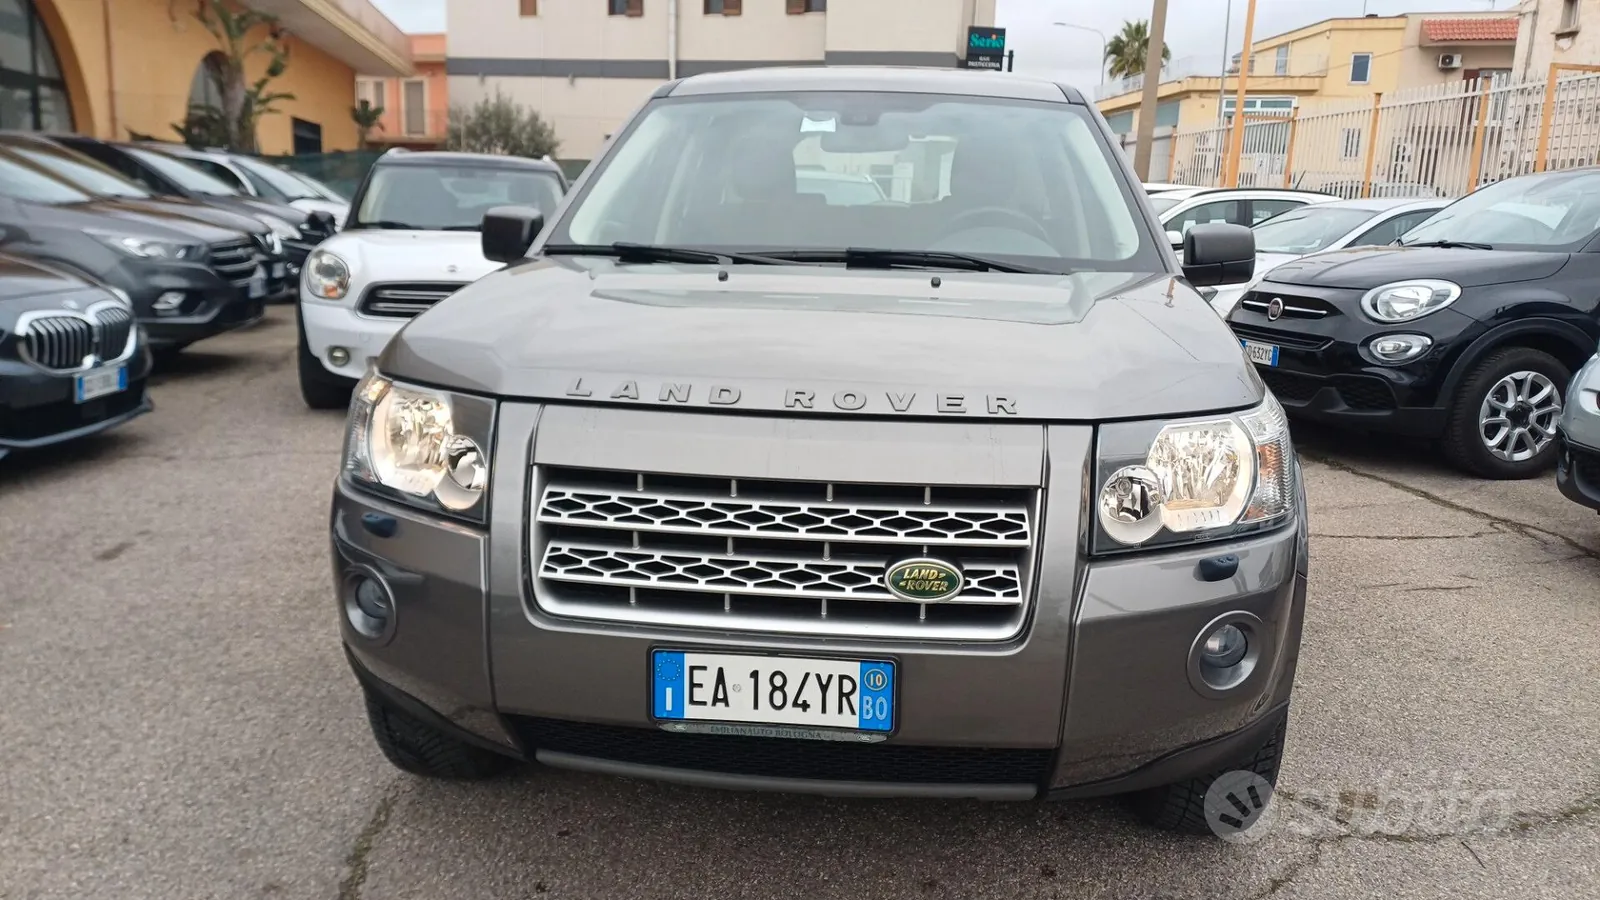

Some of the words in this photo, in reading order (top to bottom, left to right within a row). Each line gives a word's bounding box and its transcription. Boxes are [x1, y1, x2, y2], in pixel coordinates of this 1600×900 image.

[566, 377, 742, 405] LAND
[784, 387, 1018, 415] ROVER
[903, 568, 938, 580] LAND
[906, 579, 949, 591] ROVER
[868, 675, 883, 686] 10
[665, 687, 673, 711] I
[688, 665, 730, 708] EA
[749, 668, 857, 716] 184YR
[862, 695, 888, 720] BO
[775, 728, 821, 739] BOLOGNA
